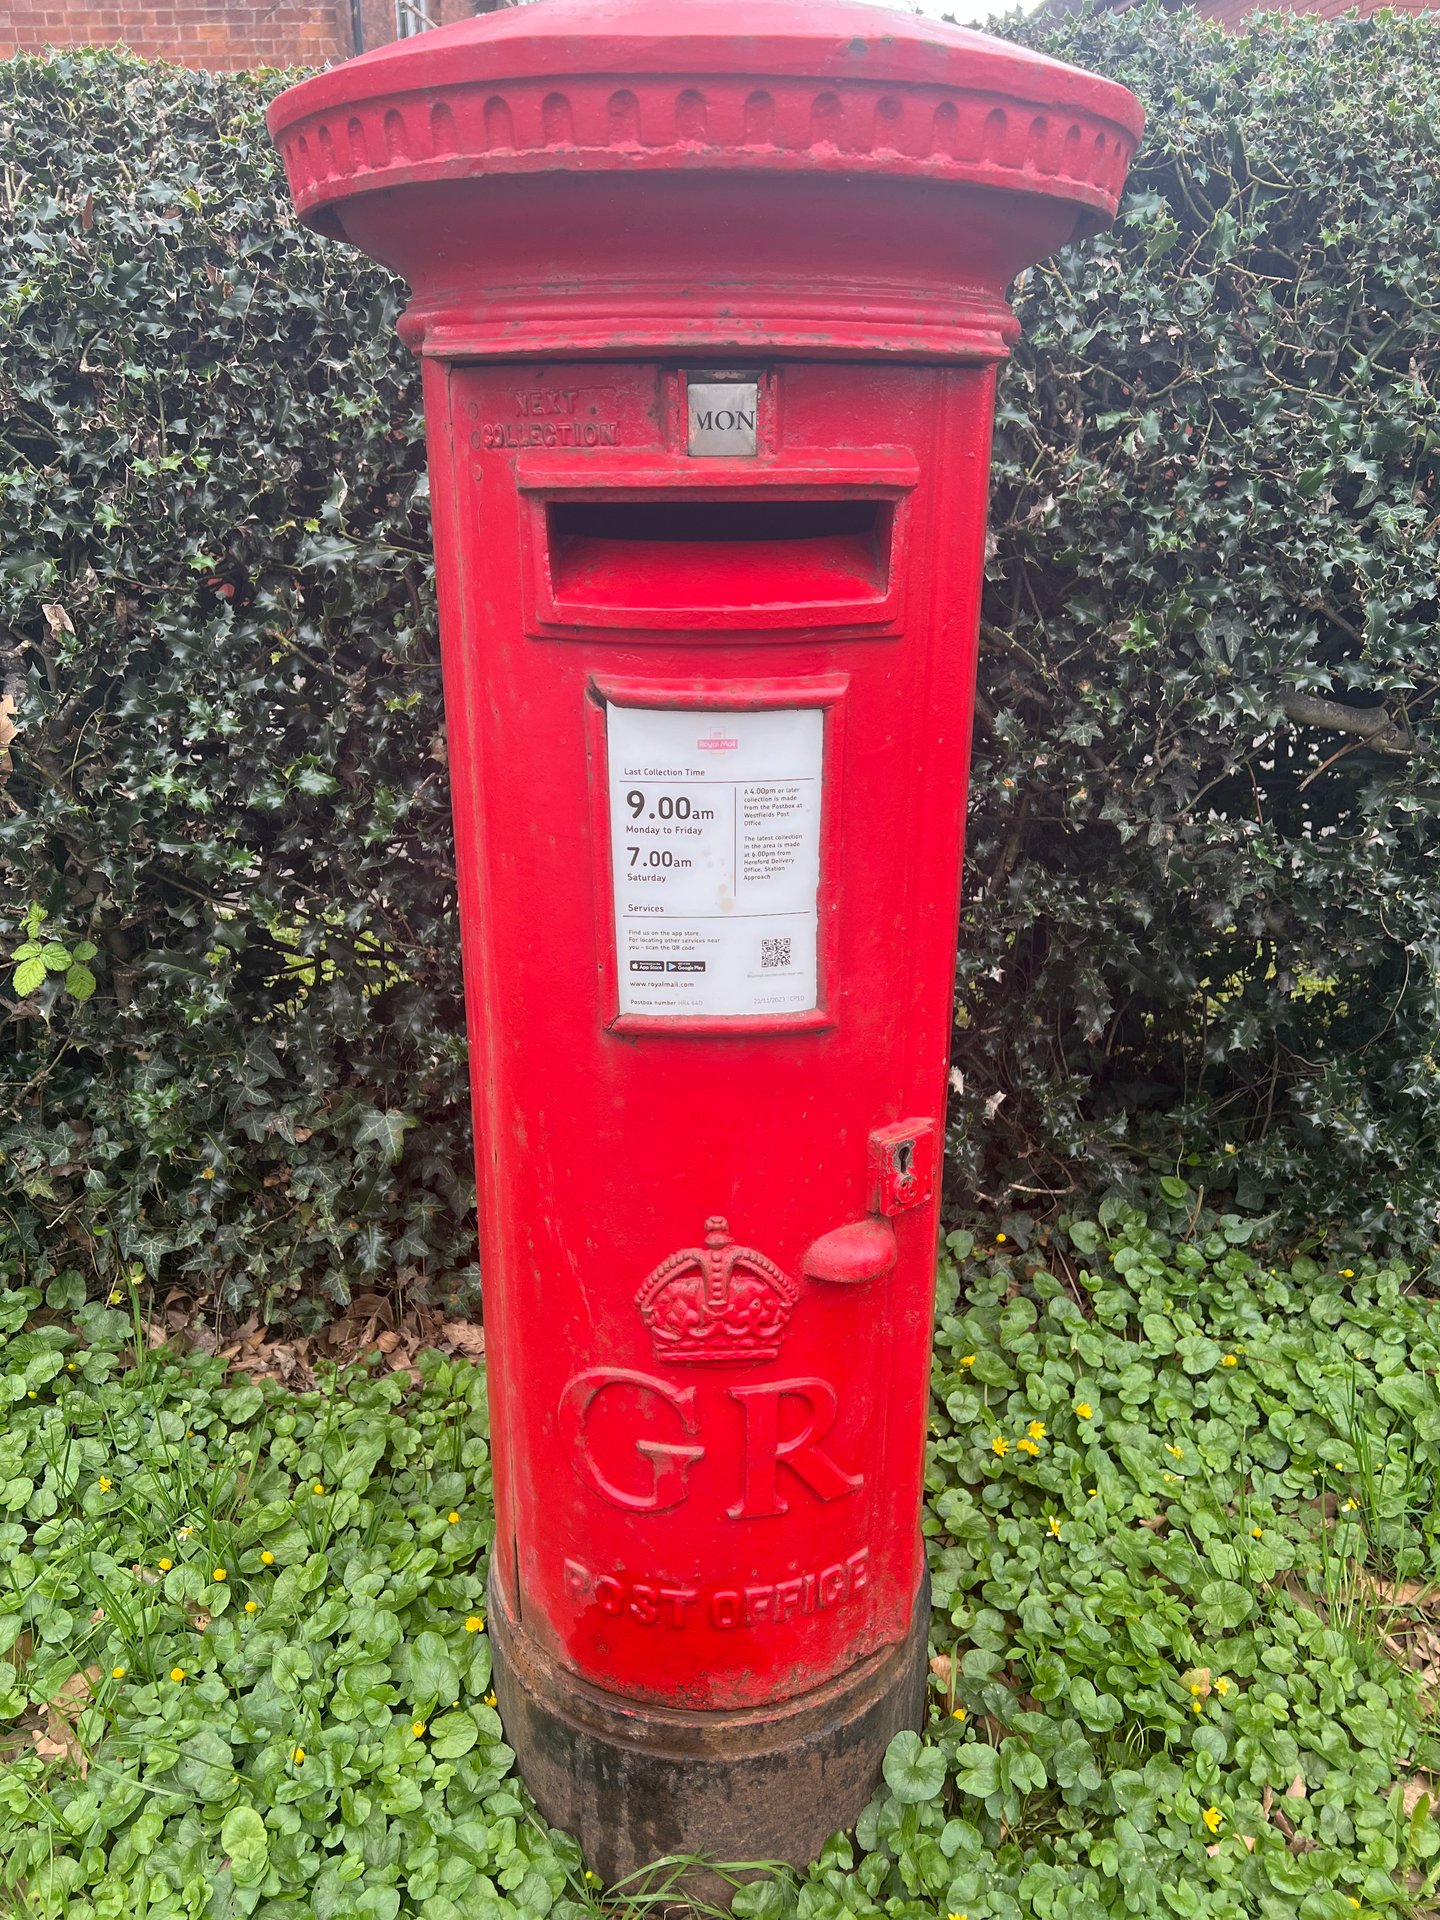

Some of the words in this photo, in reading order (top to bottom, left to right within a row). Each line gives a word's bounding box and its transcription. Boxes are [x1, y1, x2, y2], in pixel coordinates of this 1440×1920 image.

[515, 391, 578, 417] NEXT
[696, 411, 756, 431] MON
[483, 423, 621, 449] COLLECTION
[624, 768, 641, 776] Last
[644, 768, 682, 776] Collection
[750, 788, 776, 796] 4.00pm
[626, 790, 714, 820] 9.00am
[626, 826, 660, 836] Monday
[664, 826, 672, 834] to
[676, 826, 702, 836] Friday
[627, 846, 692, 868] 7.00am
[752, 850, 776, 859] 6.00pm
[627, 873, 666, 883] Saturday
[628, 904, 665, 912] Services
[630, 981, 694, 989] www.royalmail.com
[563, 1558, 697, 1630] POST
[711, 1546, 869, 1630] OFFICE
